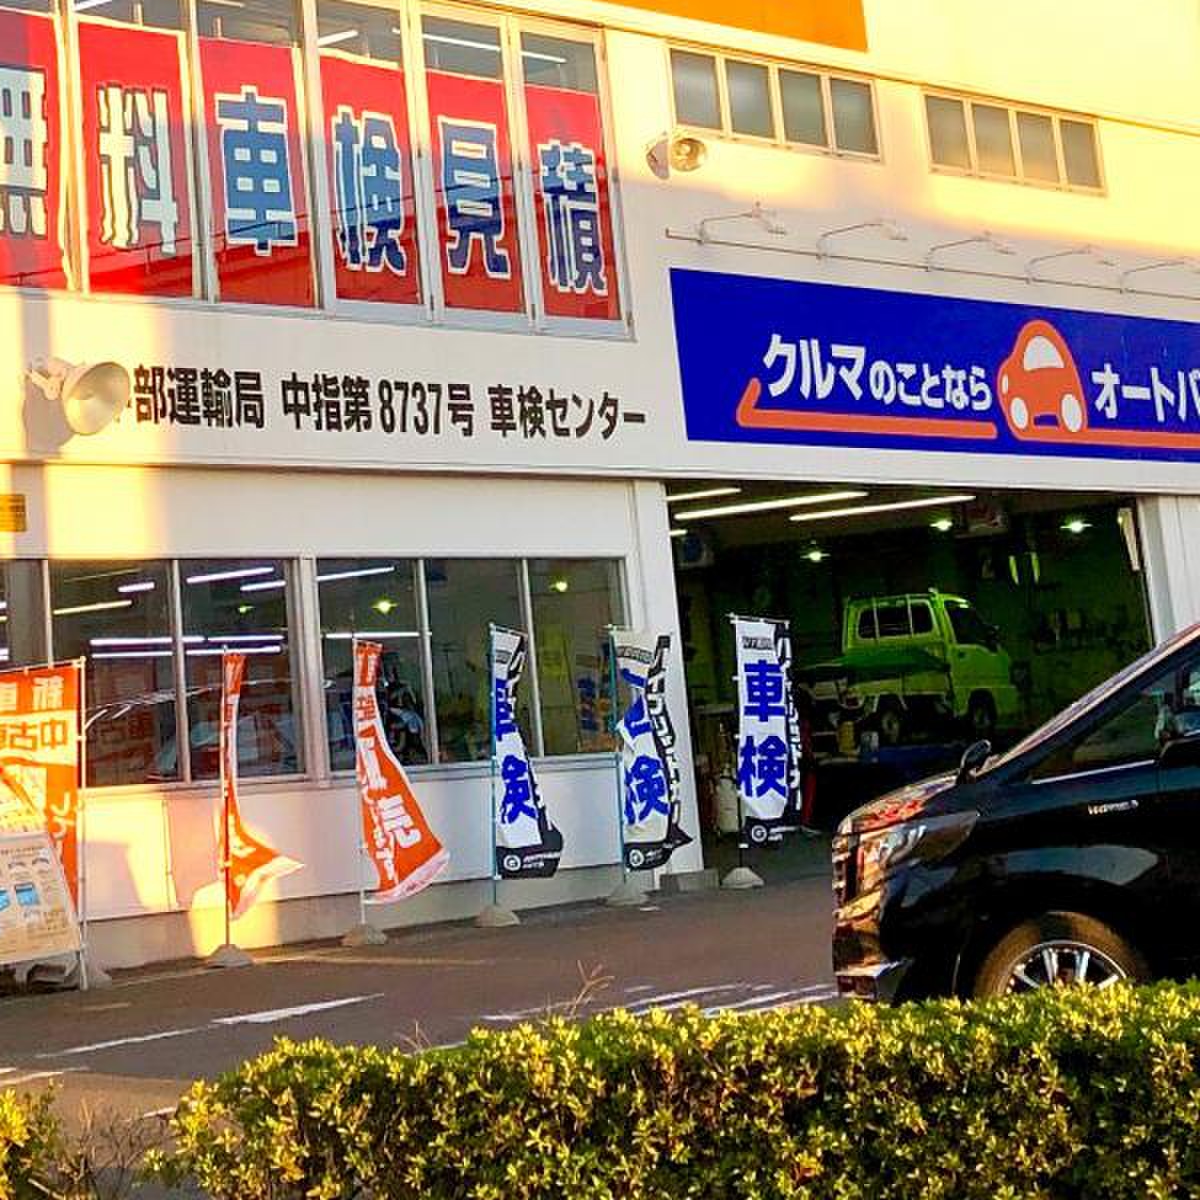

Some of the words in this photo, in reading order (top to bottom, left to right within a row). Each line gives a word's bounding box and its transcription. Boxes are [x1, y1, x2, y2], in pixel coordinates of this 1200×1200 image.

[126, 363, 266, 429] 部運輸局
[488, 383, 647, 441] 車検センター
[762, 333, 993, 411] クルマのことなら
[738, 659, 788, 798] 車検
